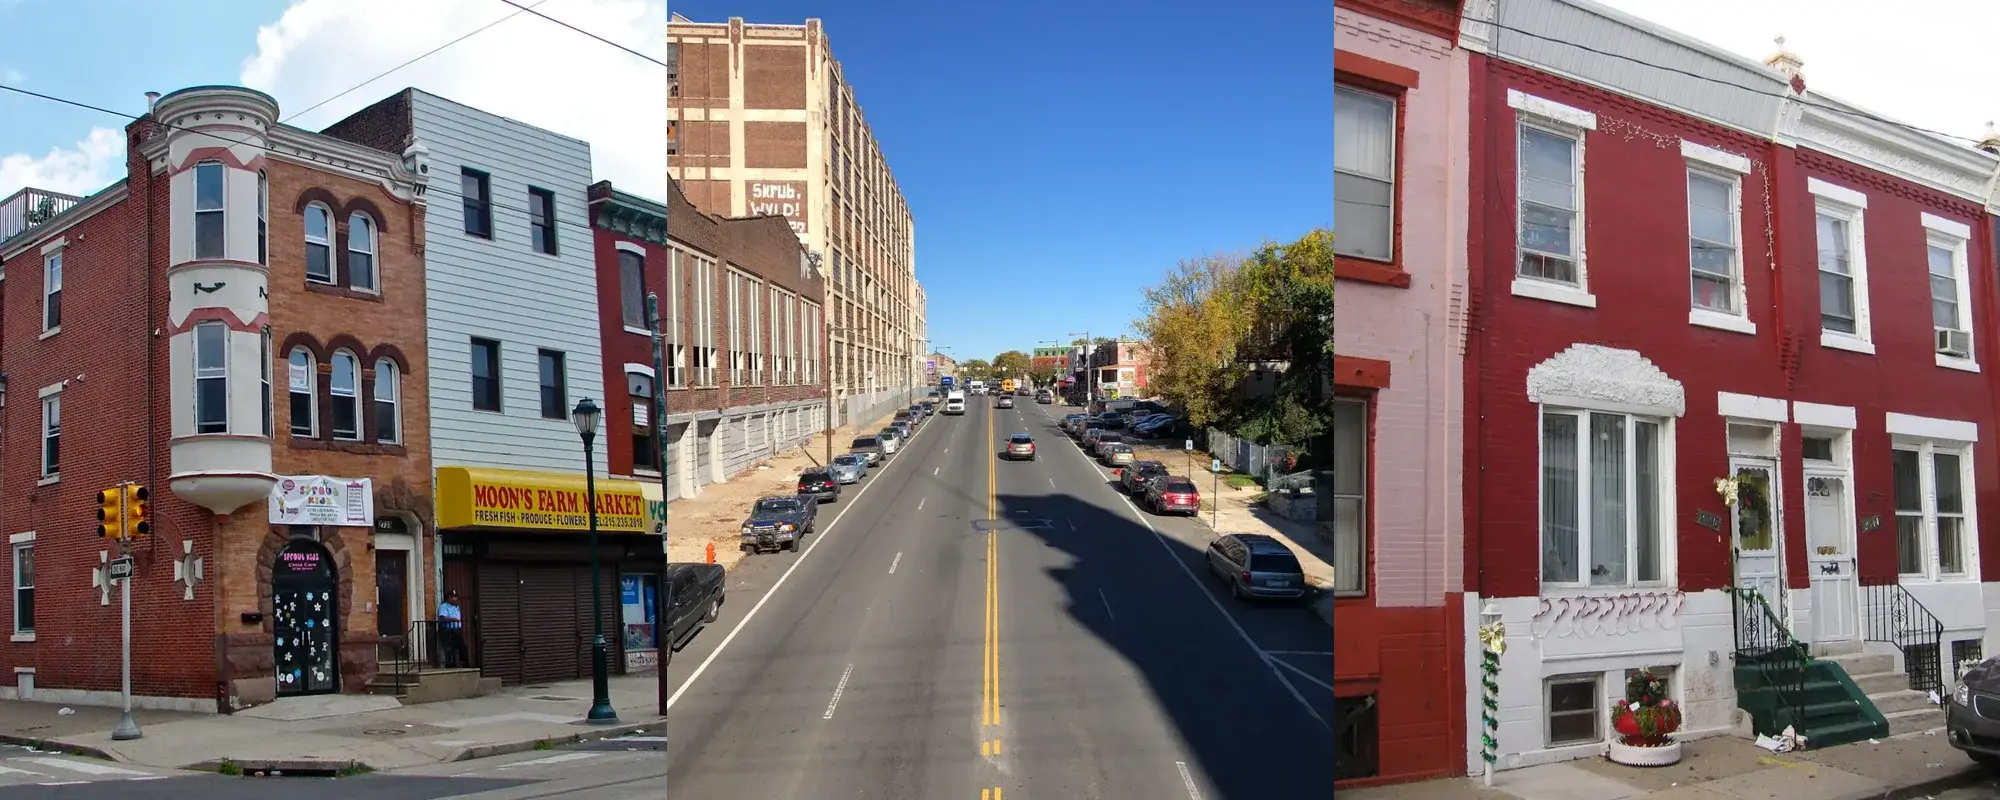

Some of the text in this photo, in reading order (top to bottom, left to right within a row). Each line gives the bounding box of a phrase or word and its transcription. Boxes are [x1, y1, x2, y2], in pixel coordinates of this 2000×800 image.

[474, 485, 641, 515] MOON'S FARM MARKET
[475, 510, 643, 528] FRESH FISH PRODUCE FLOWERS EL:215.235.2818
